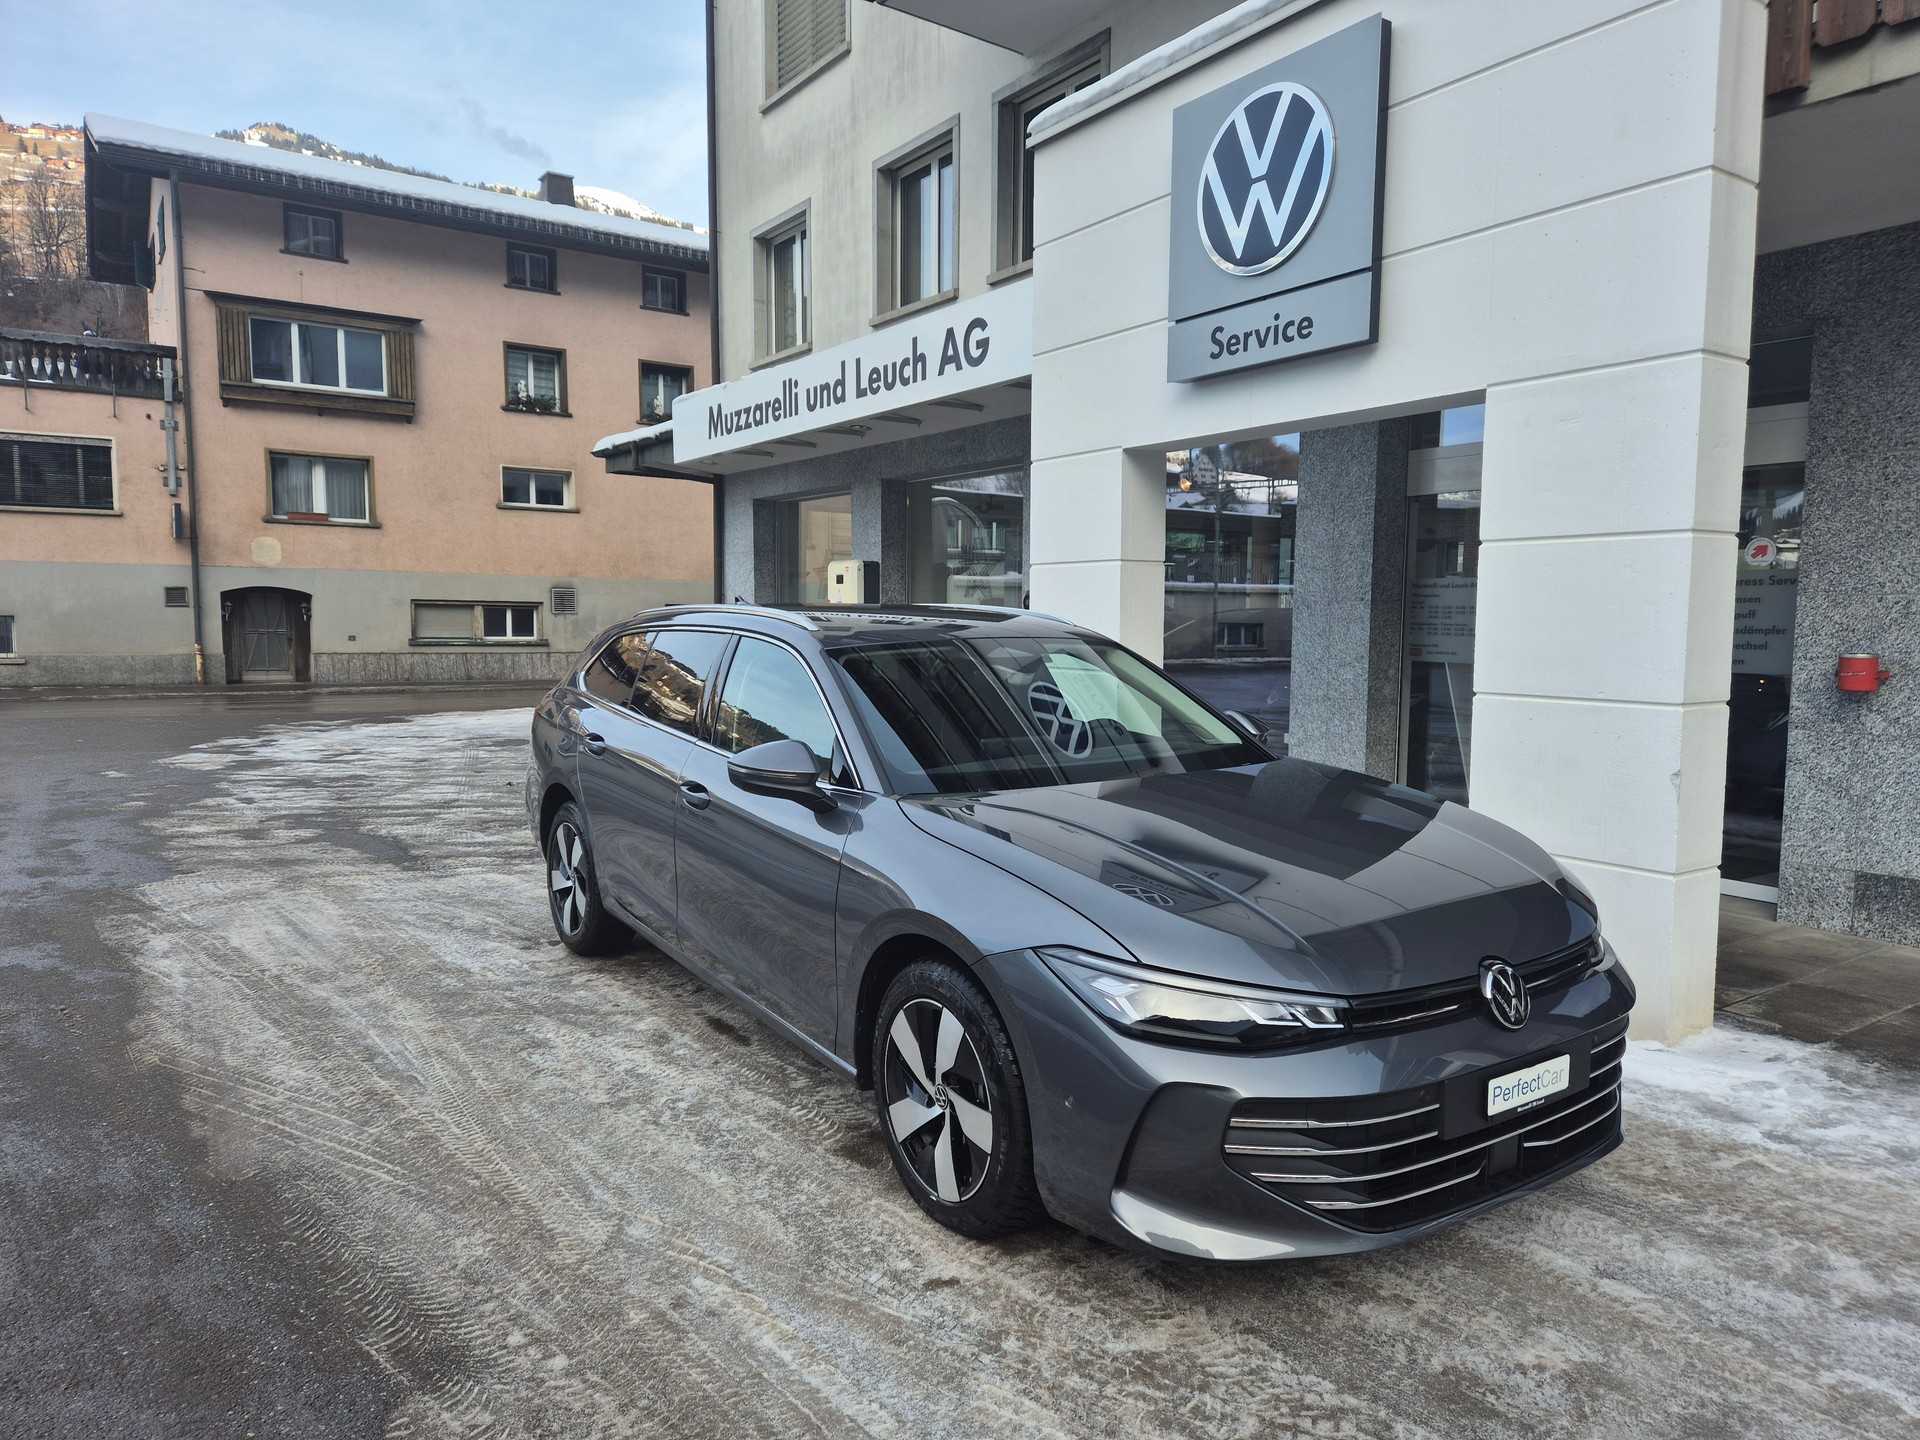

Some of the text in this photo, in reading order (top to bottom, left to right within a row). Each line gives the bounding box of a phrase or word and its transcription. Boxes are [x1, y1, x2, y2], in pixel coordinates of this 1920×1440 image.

[1209, 313, 1314, 360] Service
[708, 316, 990, 440] Muzzarelli und Leuch AG
[1733, 640, 1768, 650] echsel
[1492, 1068, 1564, 1106] PerfectCar
